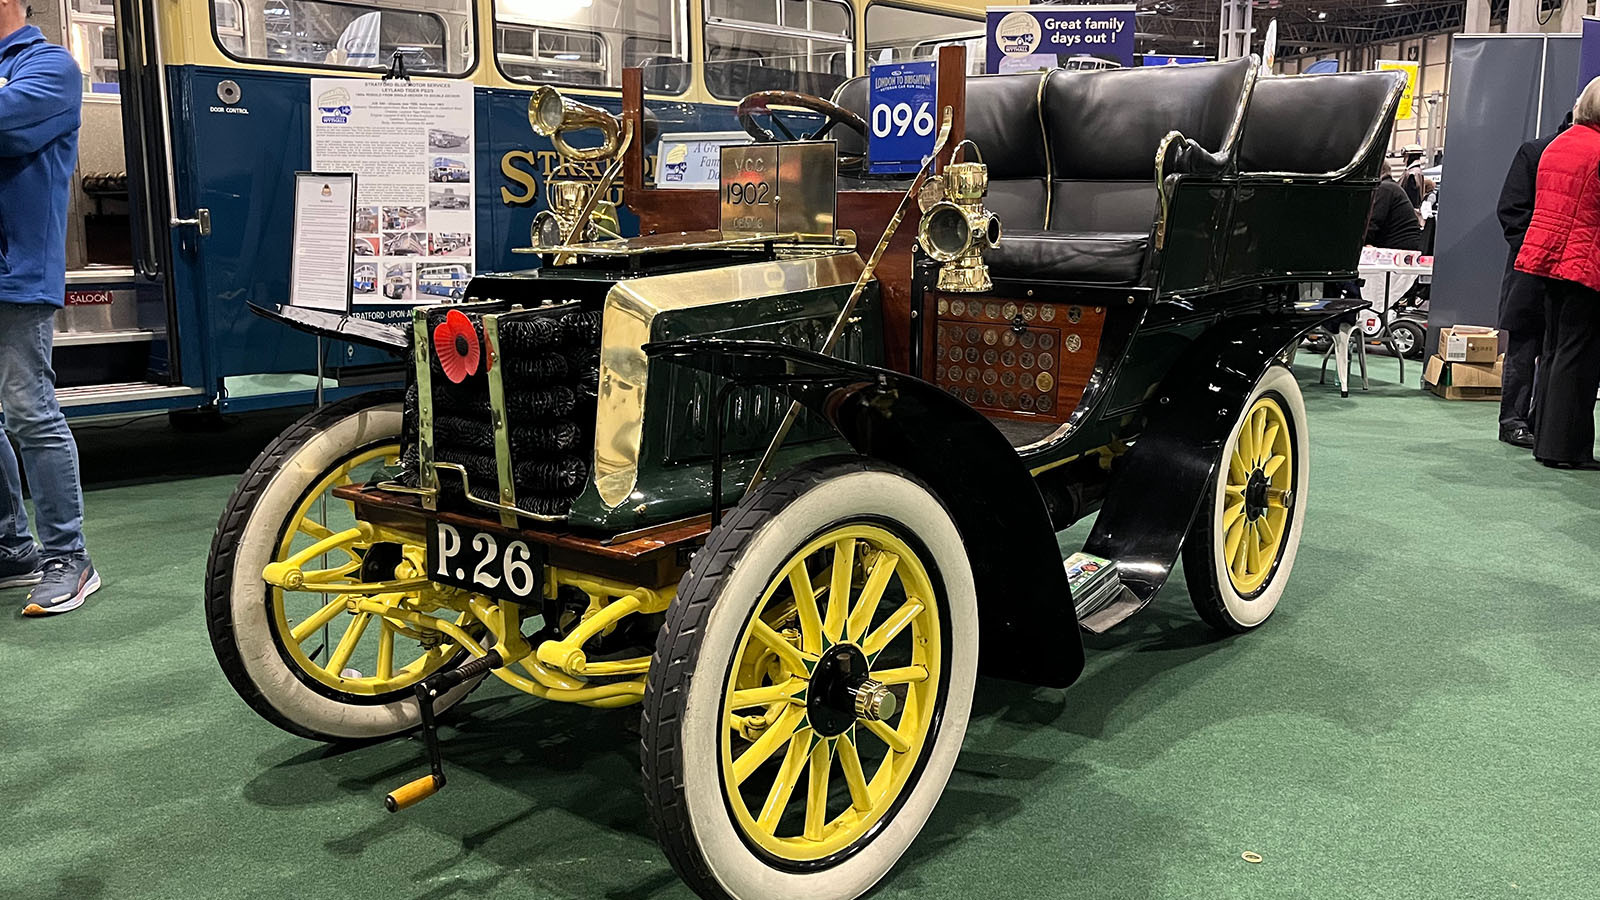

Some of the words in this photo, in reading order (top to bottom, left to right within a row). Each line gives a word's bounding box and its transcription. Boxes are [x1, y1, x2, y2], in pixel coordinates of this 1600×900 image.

[1044, 18, 1082, 30] Great
[1084, 17, 1125, 32] family
[1050, 32, 1081, 46] days
[1084, 33, 1107, 43] out
[875, 77, 897, 89] LONDON
[897, 75, 904, 84] TO
[904, 74, 931, 86] BRIGHTON
[226, 107, 249, 115] CONTROL
[872, 102, 934, 138] 096
[694, 143, 701, 153] A
[704, 142, 719, 153] Gre
[700, 156, 720, 167] Fam
[727, 182, 769, 205] 1902
[70, 293, 108, 303] SALOON
[437, 523, 534, 597] P.26
